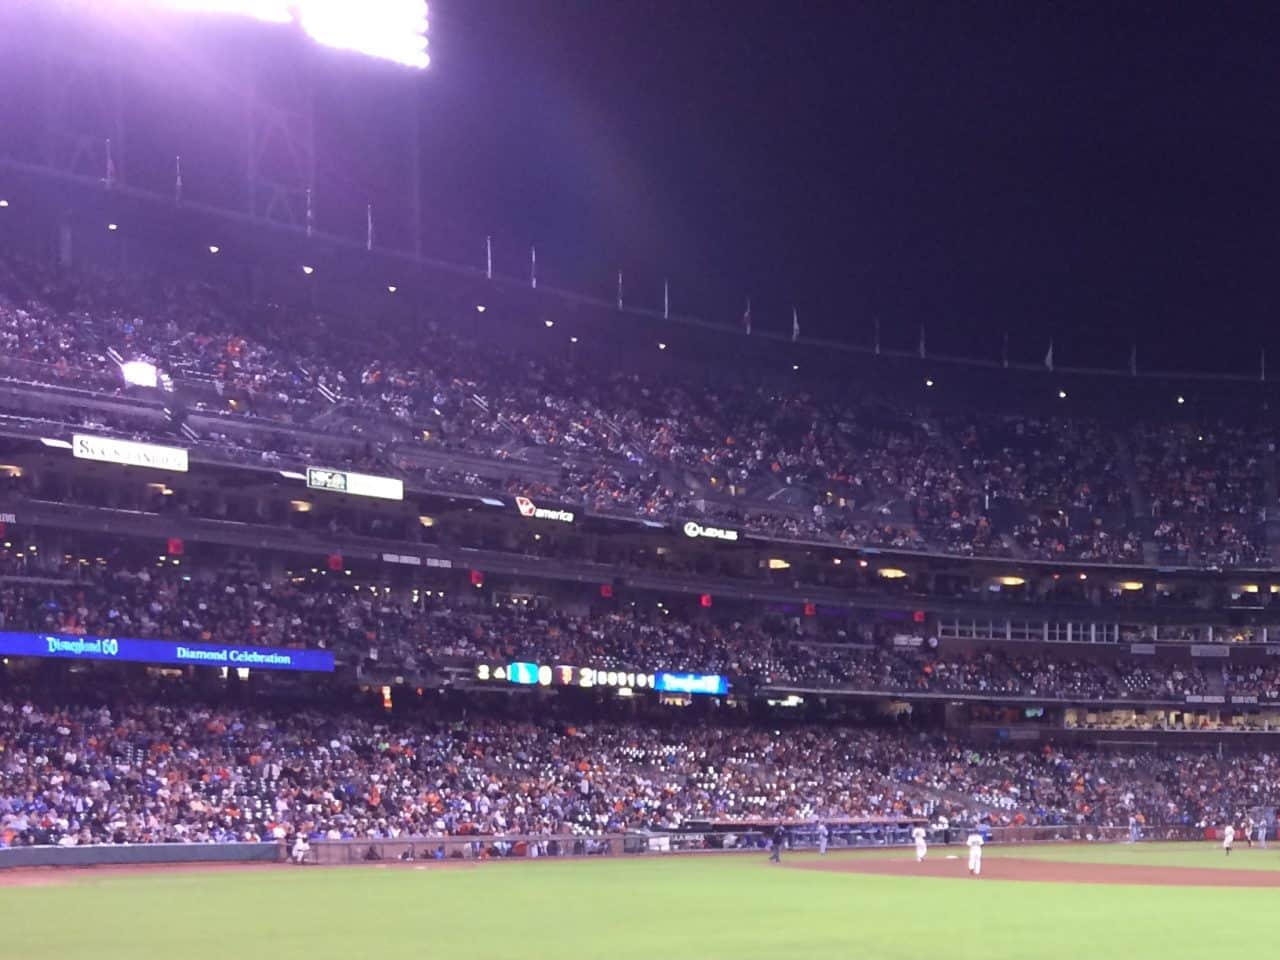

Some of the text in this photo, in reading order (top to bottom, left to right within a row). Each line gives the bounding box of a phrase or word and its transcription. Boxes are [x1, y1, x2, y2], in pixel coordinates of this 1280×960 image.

[535, 508, 574, 522] america
[102, 638, 118, 655] 60
[176, 647, 291, 665] Diamond Celebration
